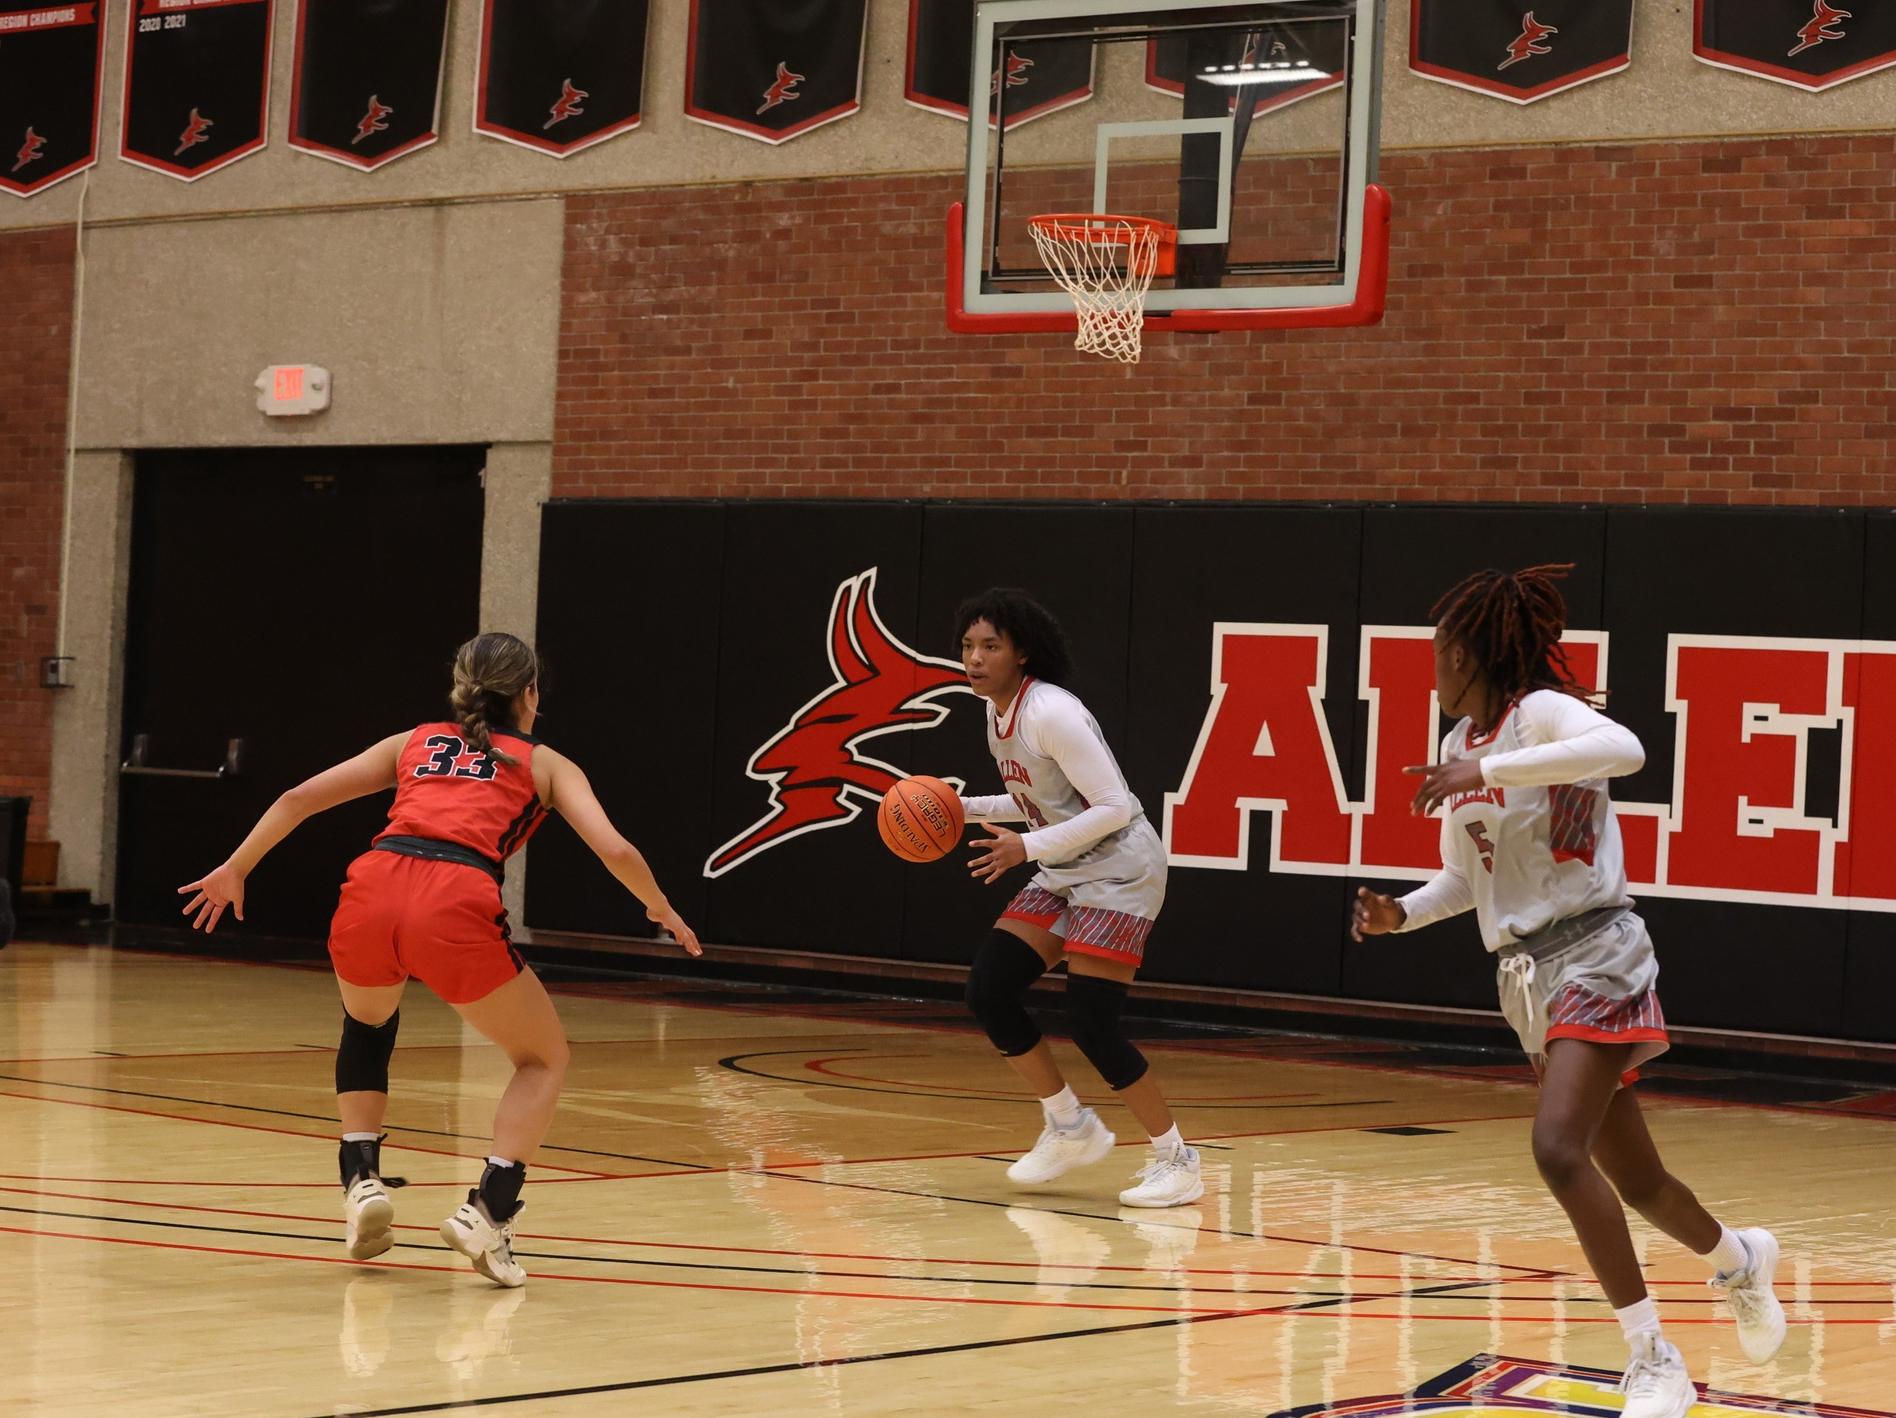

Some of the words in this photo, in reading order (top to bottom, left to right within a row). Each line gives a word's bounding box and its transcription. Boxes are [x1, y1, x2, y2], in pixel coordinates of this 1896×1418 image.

[30, 8, 76, 27] CHAMPIONS
[138, 17, 162, 33] 2020
[164, 14, 187, 29] 2021
[275, 368, 305, 400] EXIT
[413, 734, 498, 781] 33
[1163, 621, 1896, 913] ALE
[910, 794, 946, 838] LEGACY
[1464, 820, 1495, 875] 5
